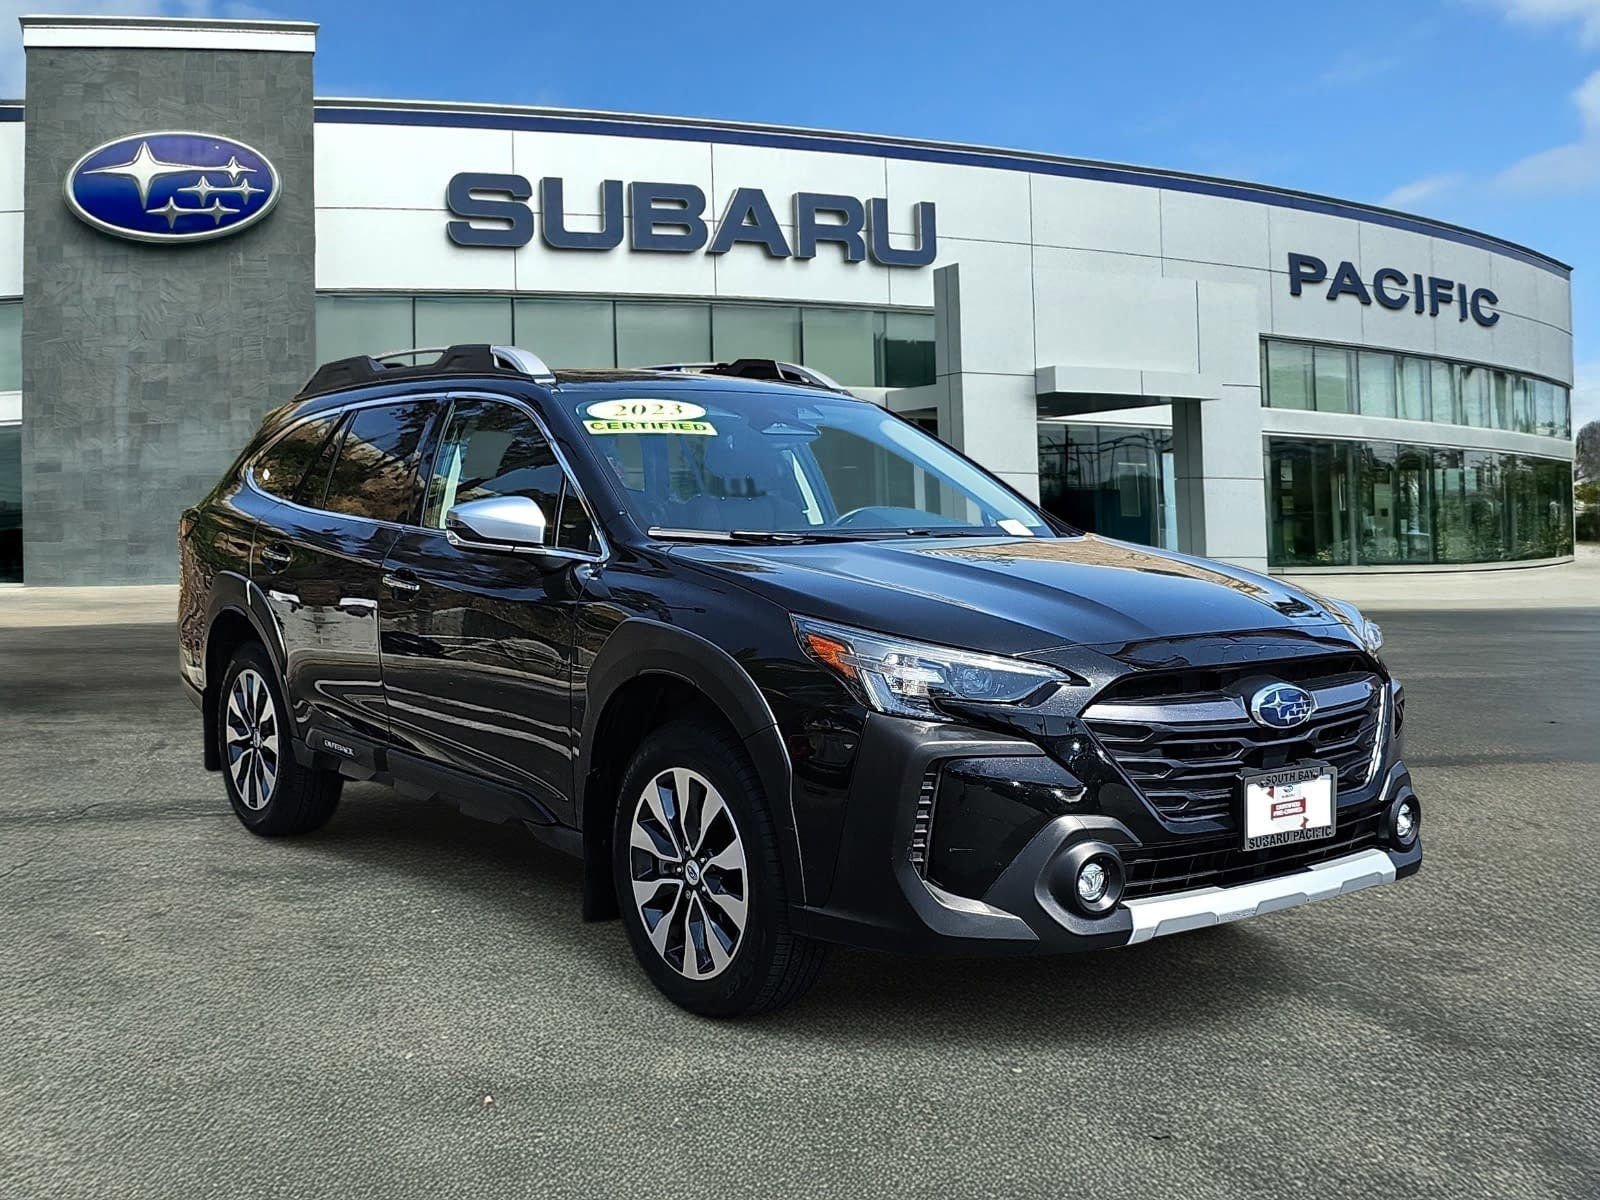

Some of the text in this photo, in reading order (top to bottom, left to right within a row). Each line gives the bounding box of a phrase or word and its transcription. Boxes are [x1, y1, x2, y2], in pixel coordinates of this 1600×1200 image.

[447, 172, 938, 268] SUBARU
[1287, 252, 1500, 328] PACIFIC
[613, 404, 684, 417] 2023
[590, 421, 707, 432] CERTIFIED
[1265, 768, 1316, 785] SOUTH BAY
[1248, 826, 1333, 849] SUBARU PACIFIC
